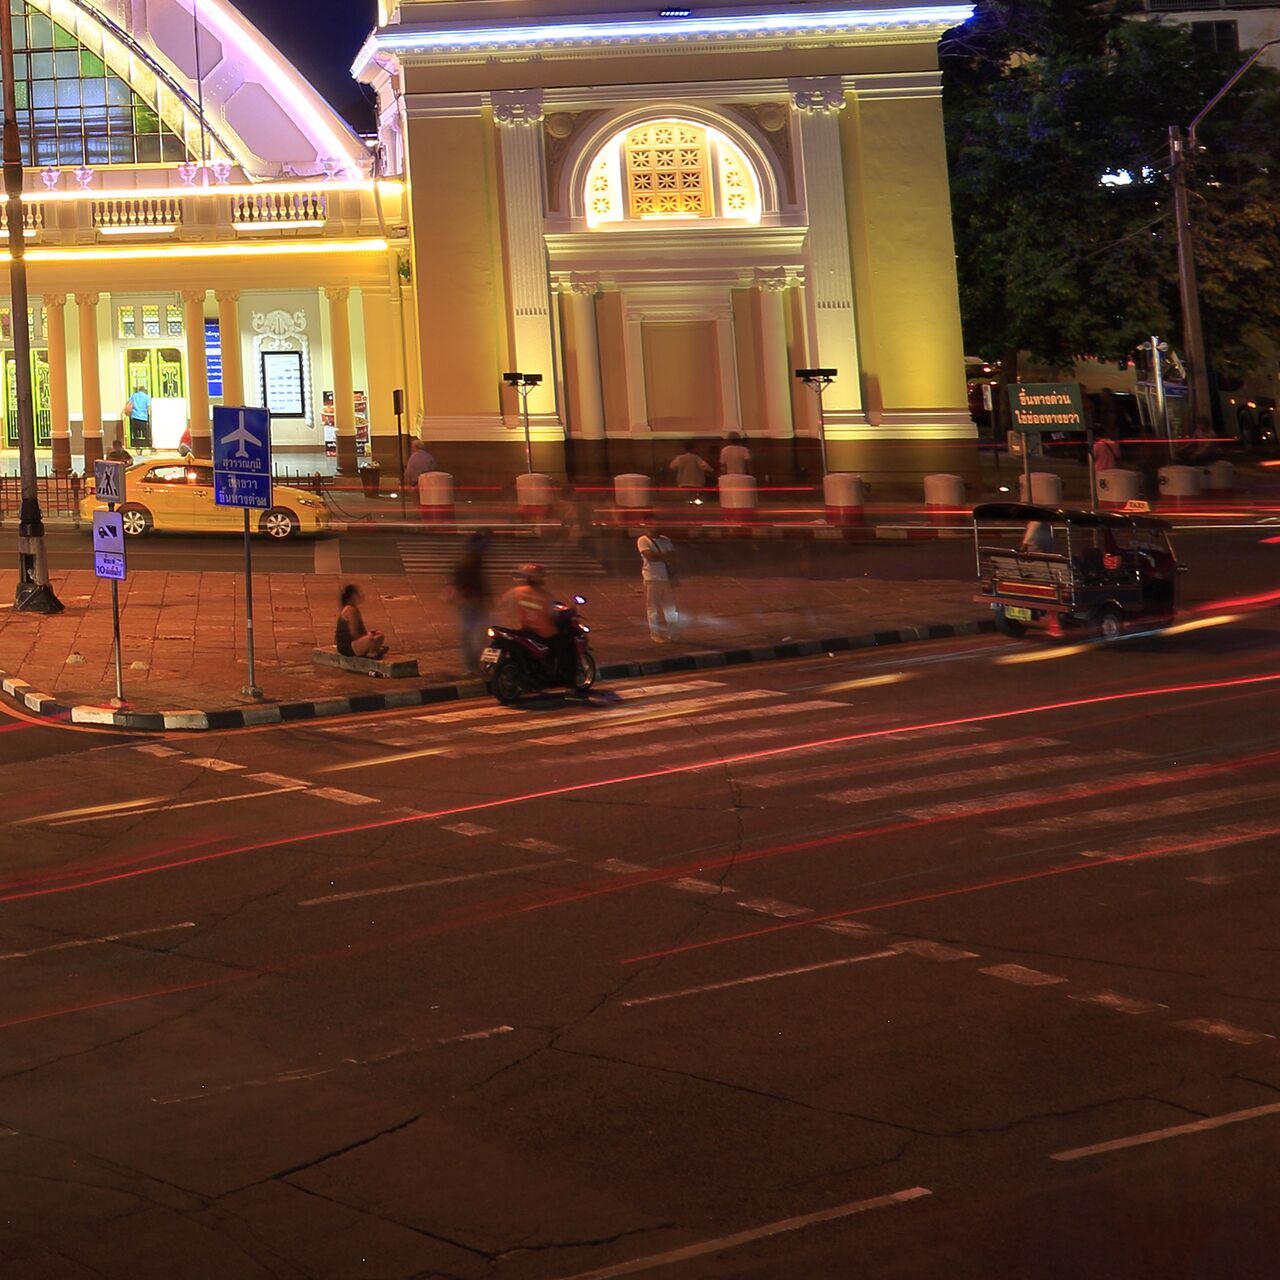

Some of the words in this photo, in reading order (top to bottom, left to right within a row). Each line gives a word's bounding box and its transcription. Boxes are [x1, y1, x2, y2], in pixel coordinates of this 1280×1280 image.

[1018, 387, 1072, 406] ขึ้นทางด่วน
[1014, 409, 1080, 424] ใช้ช่องทางขวา
[223, 458, 262, 472] สุวรรณภูมิ
